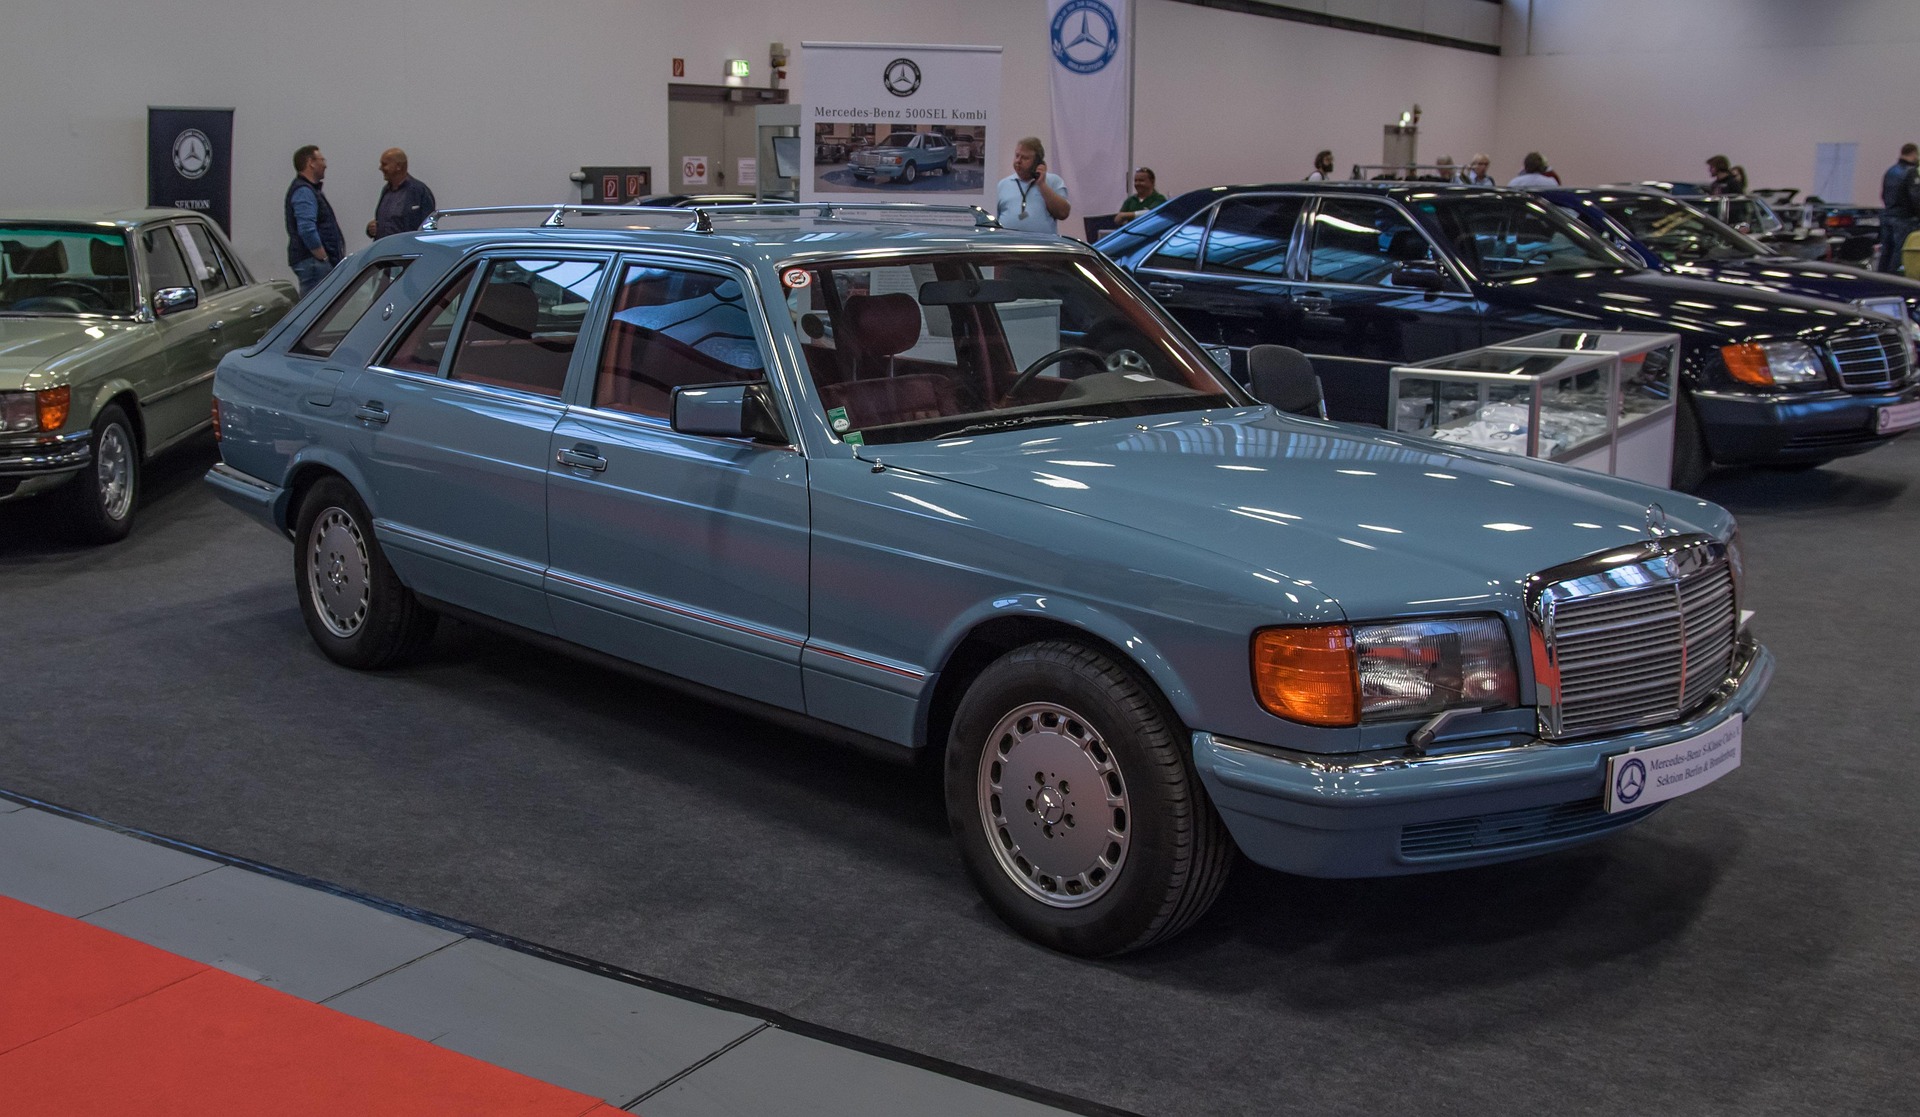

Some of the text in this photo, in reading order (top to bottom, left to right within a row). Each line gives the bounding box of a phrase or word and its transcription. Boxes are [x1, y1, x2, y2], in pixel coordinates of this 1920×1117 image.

[814, 106, 987, 120] Mercedes-Benz 500SEL Kombi
[1650, 750, 1702, 771] Mercedes-Benz
[1656, 772, 1683, 787] Sektion
[1685, 765, 1703, 779] Berlin
